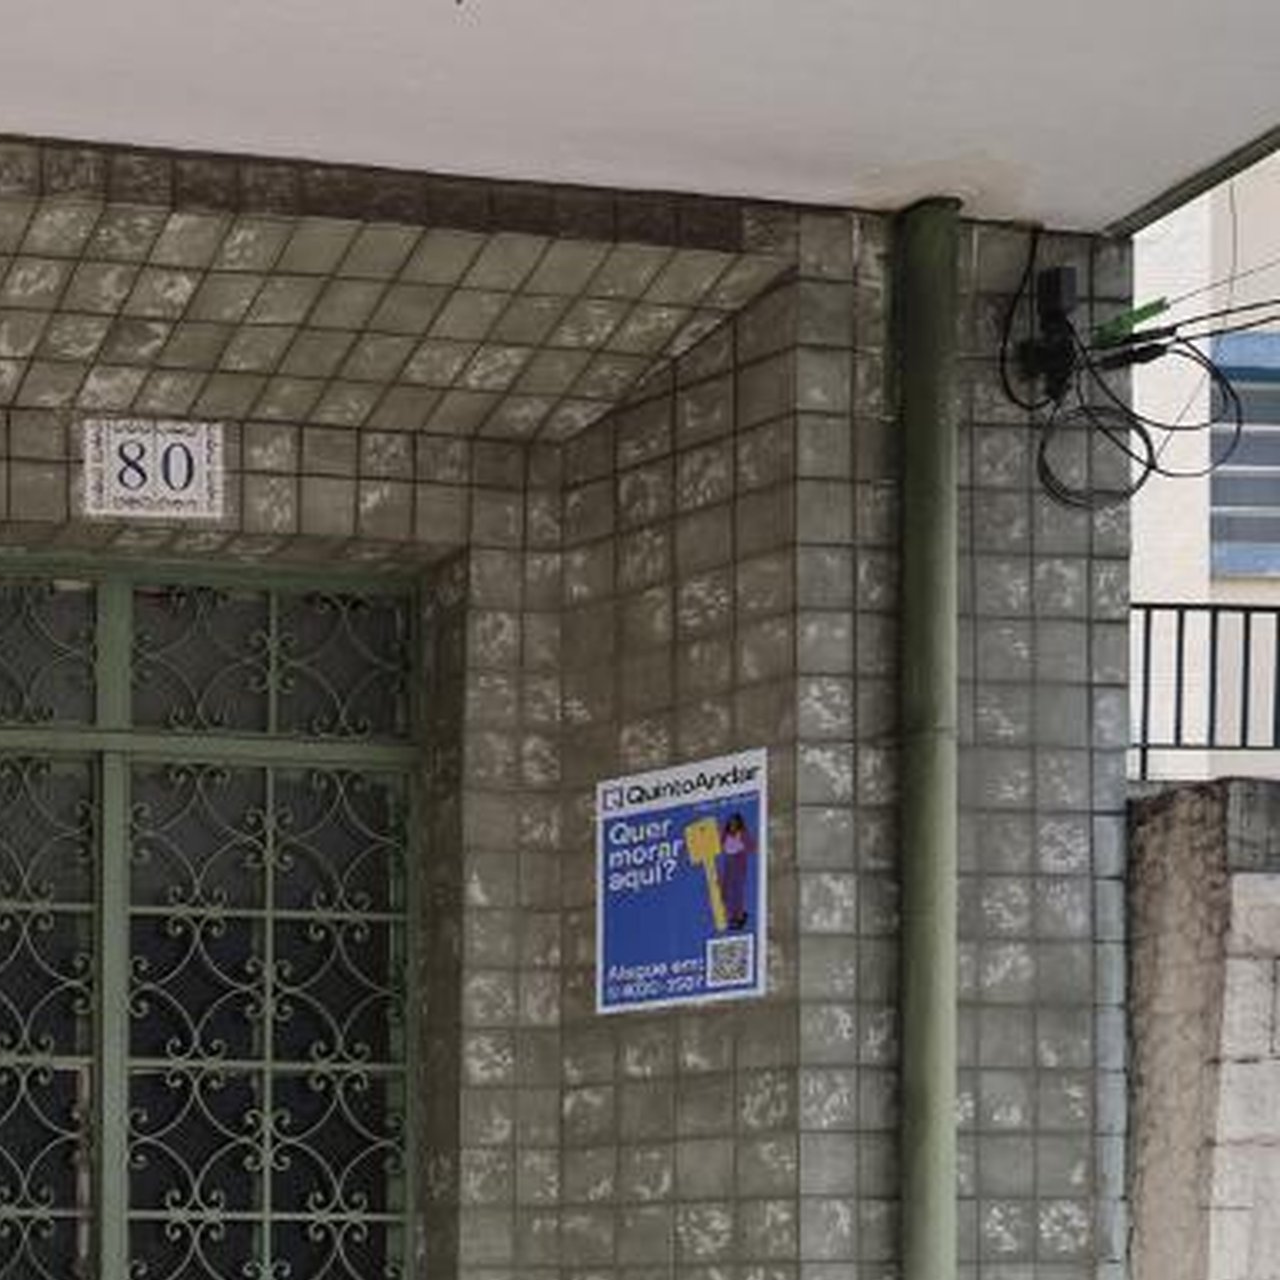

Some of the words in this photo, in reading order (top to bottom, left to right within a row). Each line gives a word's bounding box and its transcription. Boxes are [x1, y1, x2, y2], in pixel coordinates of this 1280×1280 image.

[117, 441, 195, 492] 80
[626, 766, 761, 805] QuintoAndar
[609, 819, 673, 846] Quer
[609, 838, 683, 868] morar
[609, 860, 678, 892] aqui?
